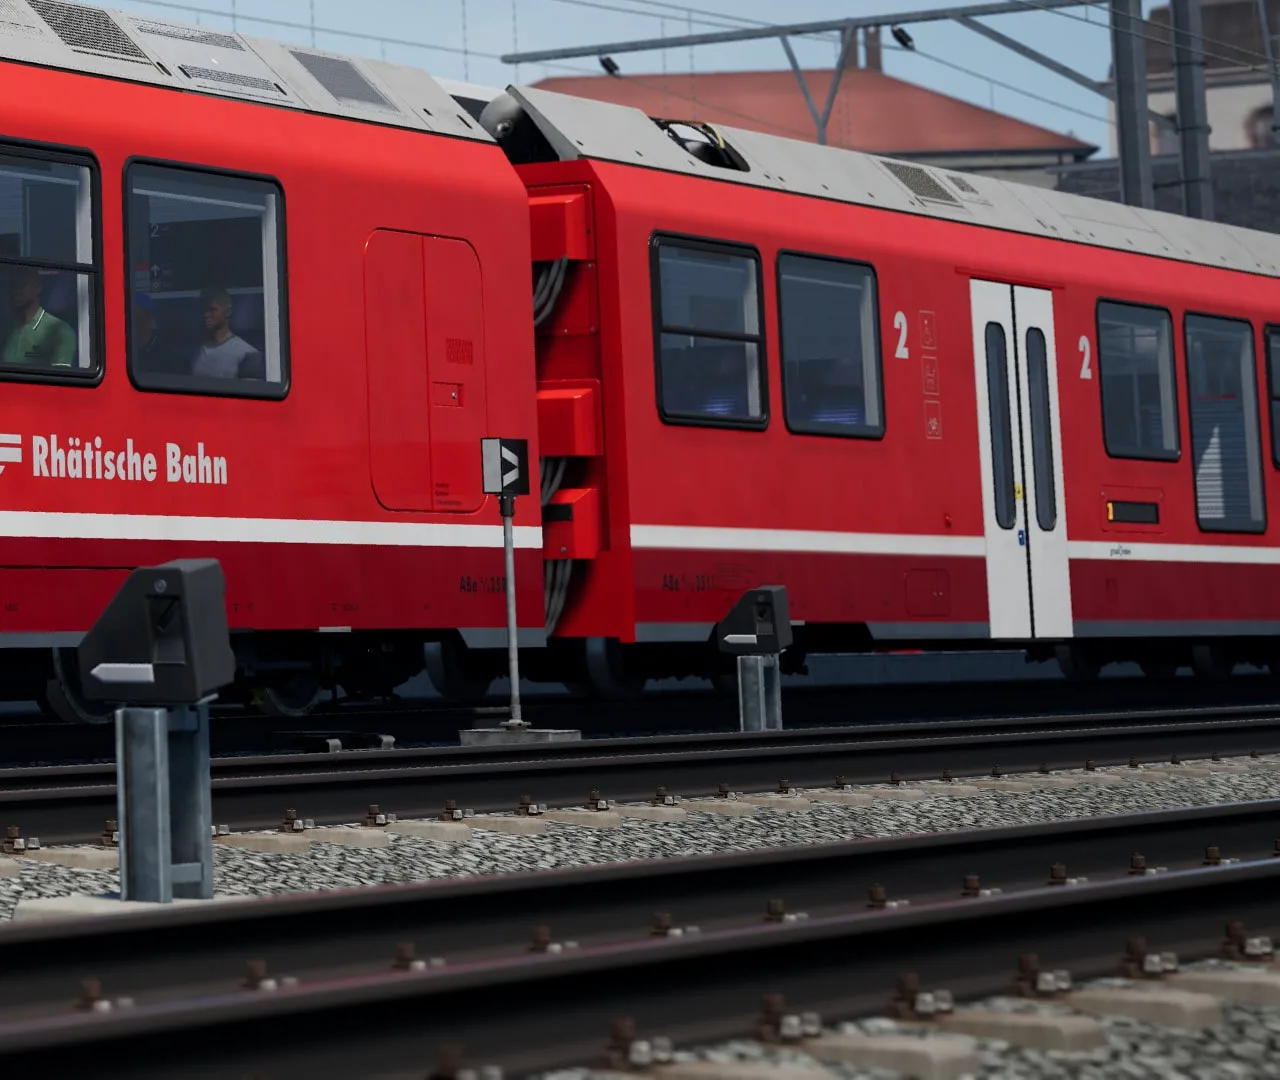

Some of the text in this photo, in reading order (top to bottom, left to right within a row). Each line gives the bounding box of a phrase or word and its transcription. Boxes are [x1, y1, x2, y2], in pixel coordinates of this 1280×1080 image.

[893, 310, 910, 360] 2
[1078, 335, 1093, 380] 2
[32, 434, 229, 486] Rhätische Bahn
